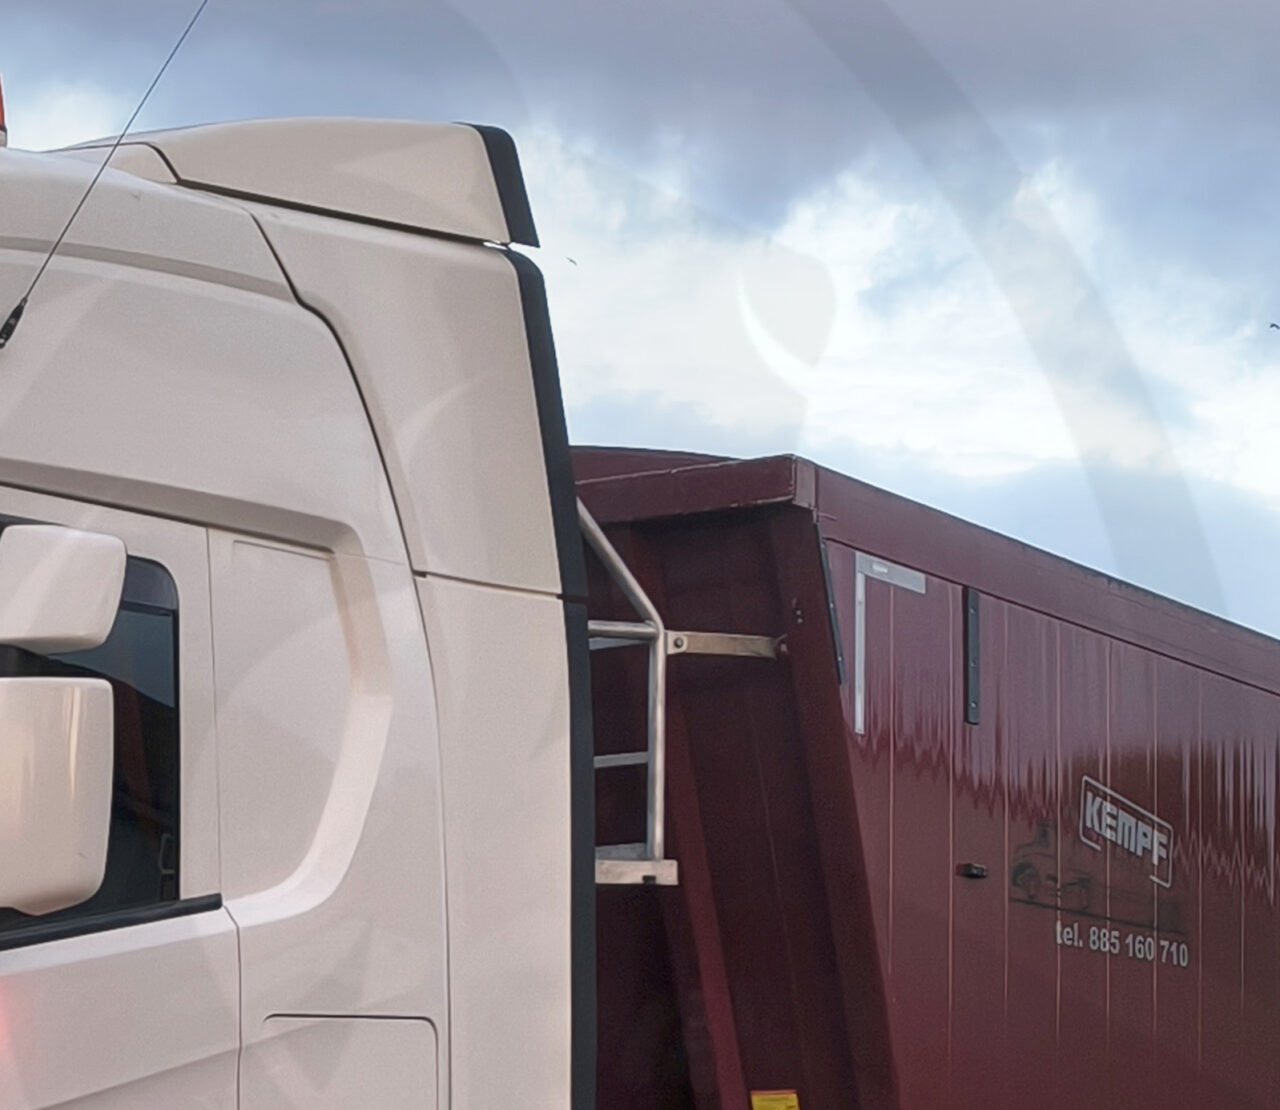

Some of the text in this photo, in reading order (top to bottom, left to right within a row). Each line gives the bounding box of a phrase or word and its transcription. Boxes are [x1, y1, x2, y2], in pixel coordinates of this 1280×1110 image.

[1085, 791, 1168, 866] KEMPF
[1056, 920, 1188, 967] tel. 885 160 710
